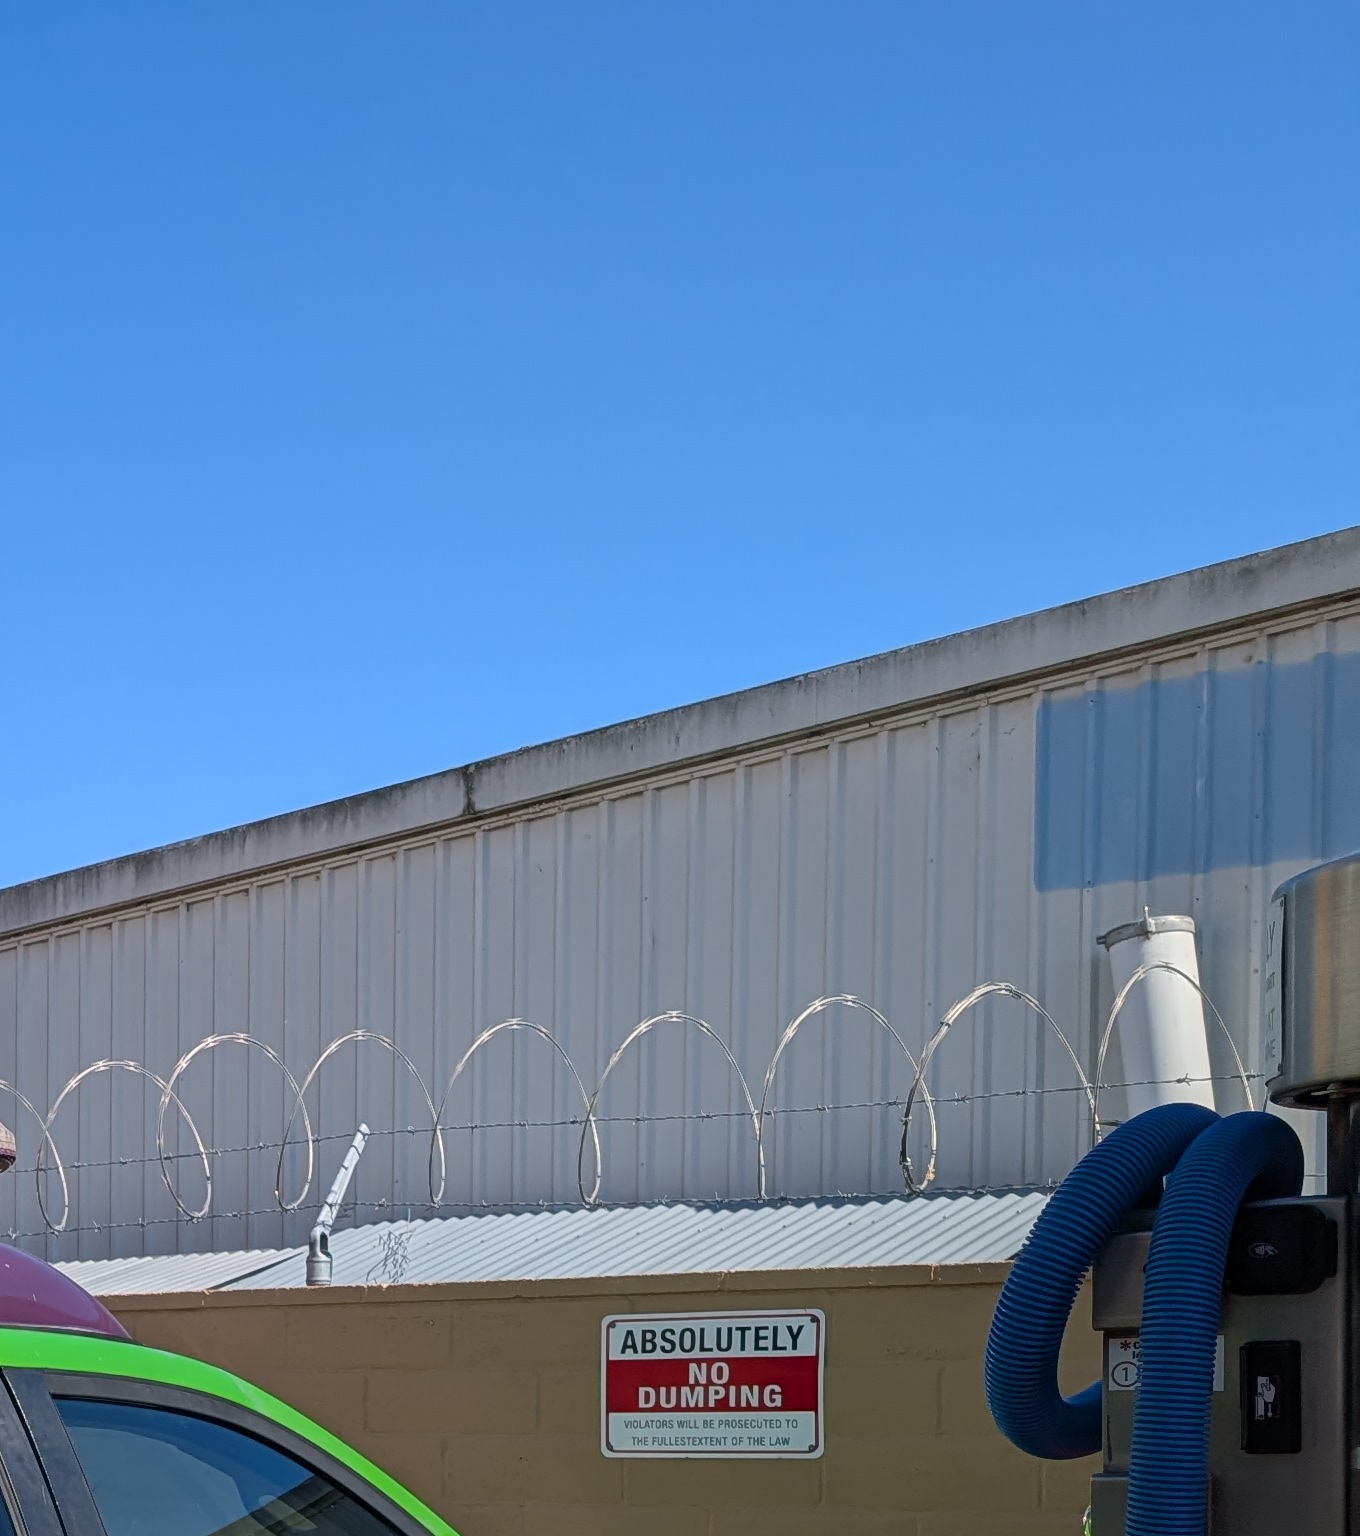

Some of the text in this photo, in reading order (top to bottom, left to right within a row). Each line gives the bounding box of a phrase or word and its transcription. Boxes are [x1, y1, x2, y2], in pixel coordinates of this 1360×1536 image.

[620, 1325, 804, 1354] ABSOLUTELY
[688, 1361, 730, 1384] NO
[638, 1384, 783, 1408] DUMPING
[624, 1418, 798, 1429] VIOLATORS WILL BE PROSECUTED TO
[632, 1436, 649, 1446] THE
[731, 1436, 744, 1446] OF
[747, 1436, 766, 1446] THE
[769, 1436, 790, 1446] LAW
